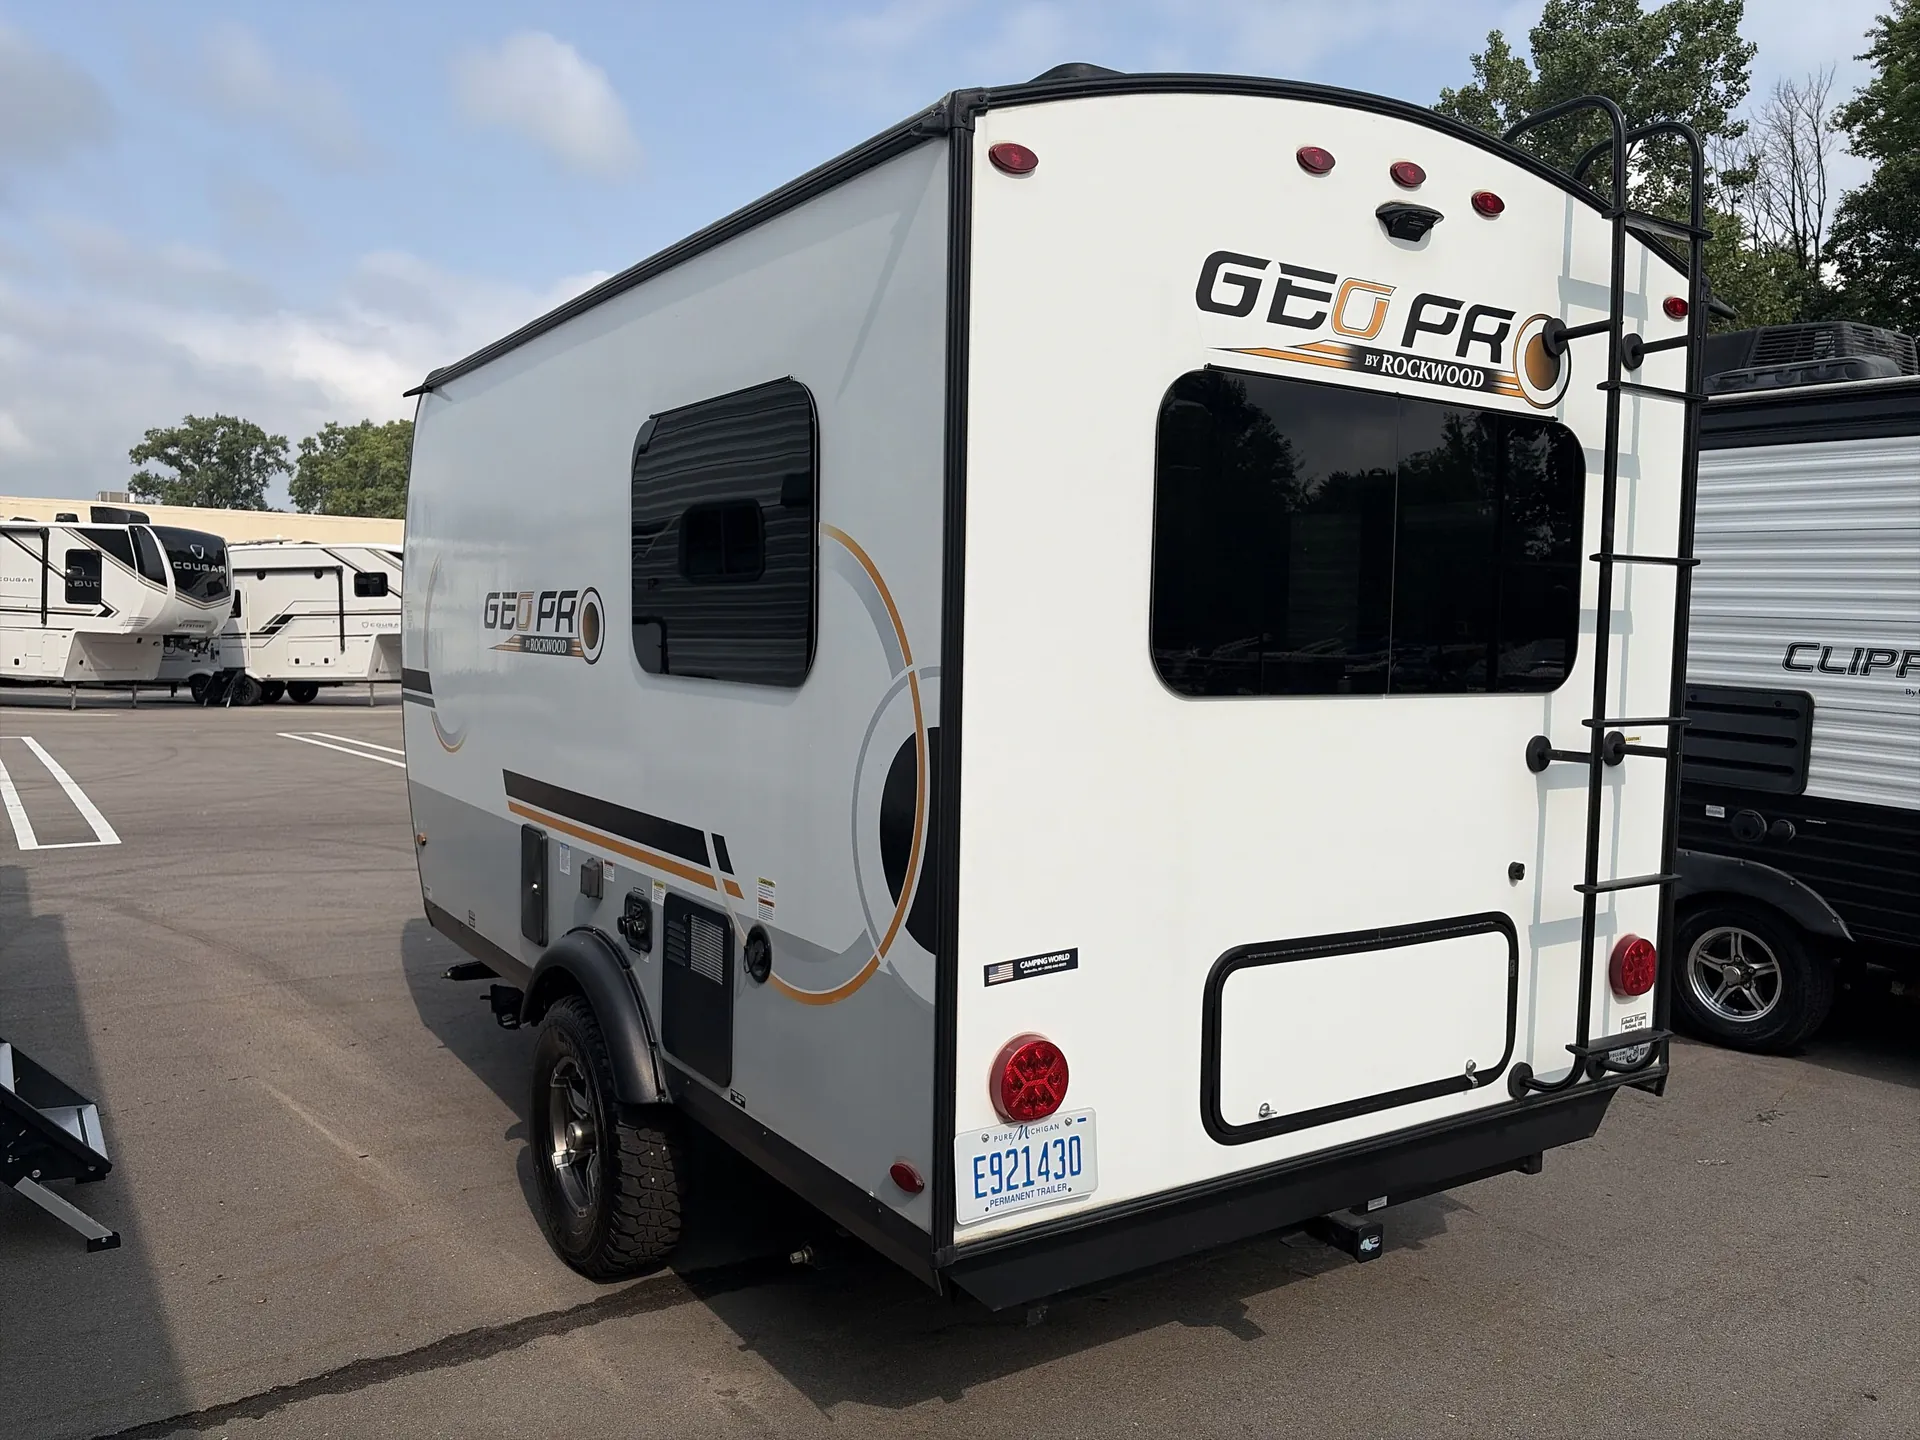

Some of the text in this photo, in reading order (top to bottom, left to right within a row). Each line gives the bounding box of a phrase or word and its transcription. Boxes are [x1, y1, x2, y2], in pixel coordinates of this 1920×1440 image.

[1195, 250, 1398, 341] GEO
[1364, 353, 1485, 388] BY ROCKWOOD
[172, 561, 226, 574] COUGAR
[483, 591, 535, 632] GEO
[530, 638, 567, 653] ROCKWOOD
[1020, 957, 1048, 969] CAMPING
[1047, 953, 1070, 964] WORLD
[993, 1123, 1060, 1146] PURE MICHIGAN
[973, 1135, 1082, 1199] E921430
[989, 1183, 1068, 1208] PERMANENT TRAILER
